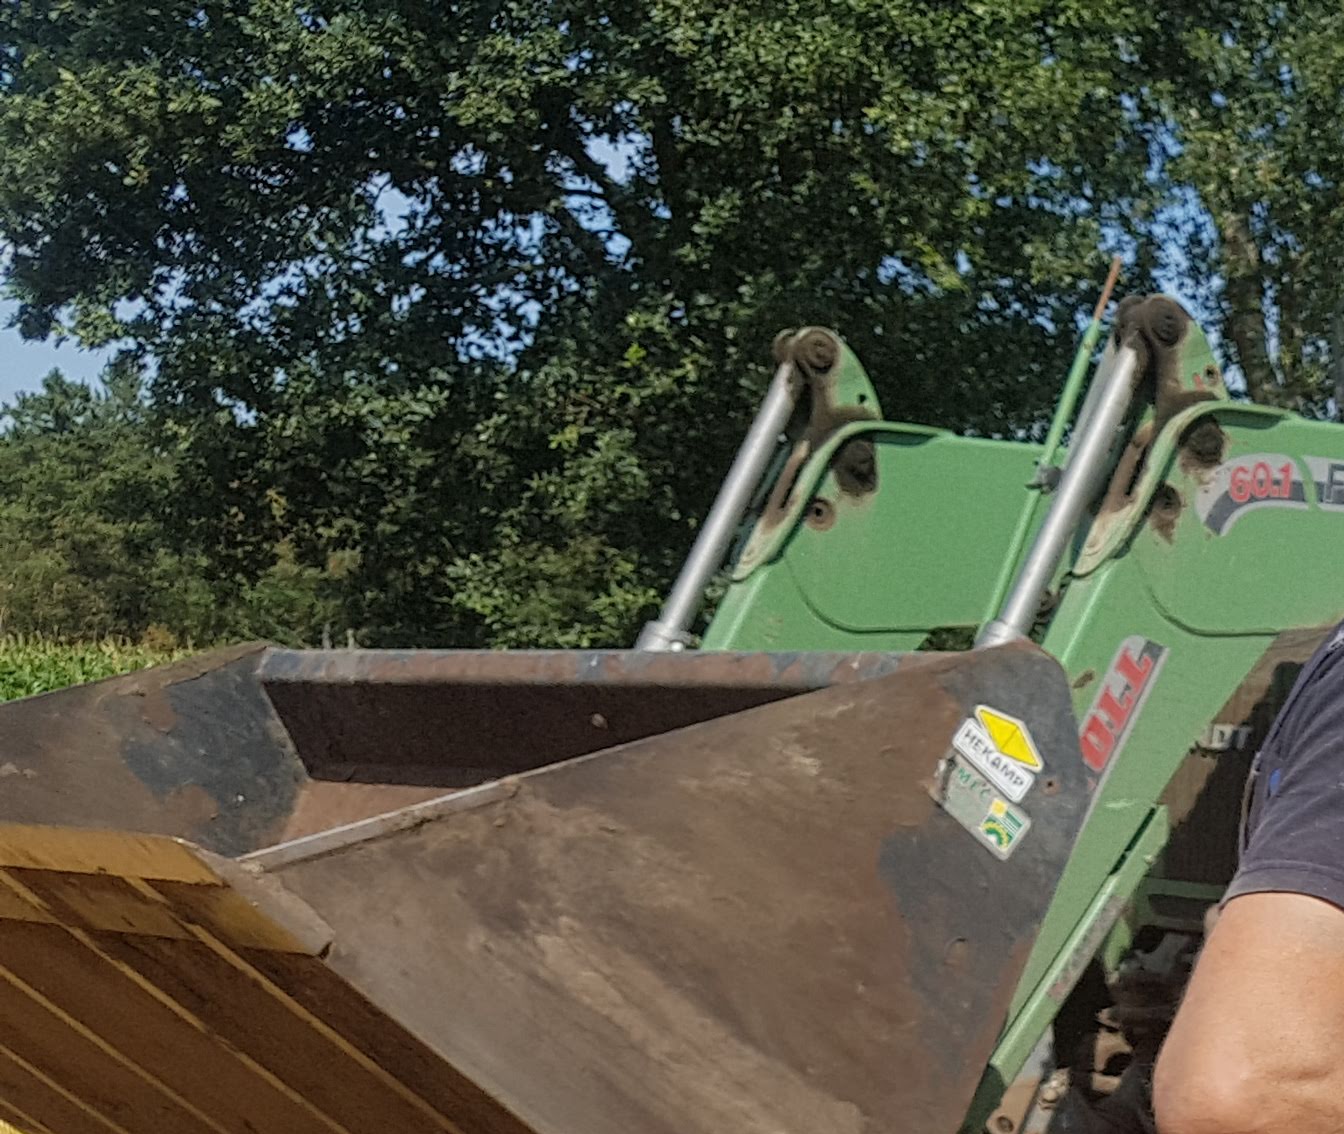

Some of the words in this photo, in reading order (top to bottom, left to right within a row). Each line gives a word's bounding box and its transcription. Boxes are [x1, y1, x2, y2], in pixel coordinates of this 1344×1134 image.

[1229, 462, 1293, 503] 60.1
[1079, 646, 1154, 780] OLL
[963, 728, 1025, 788] HEKAMP
